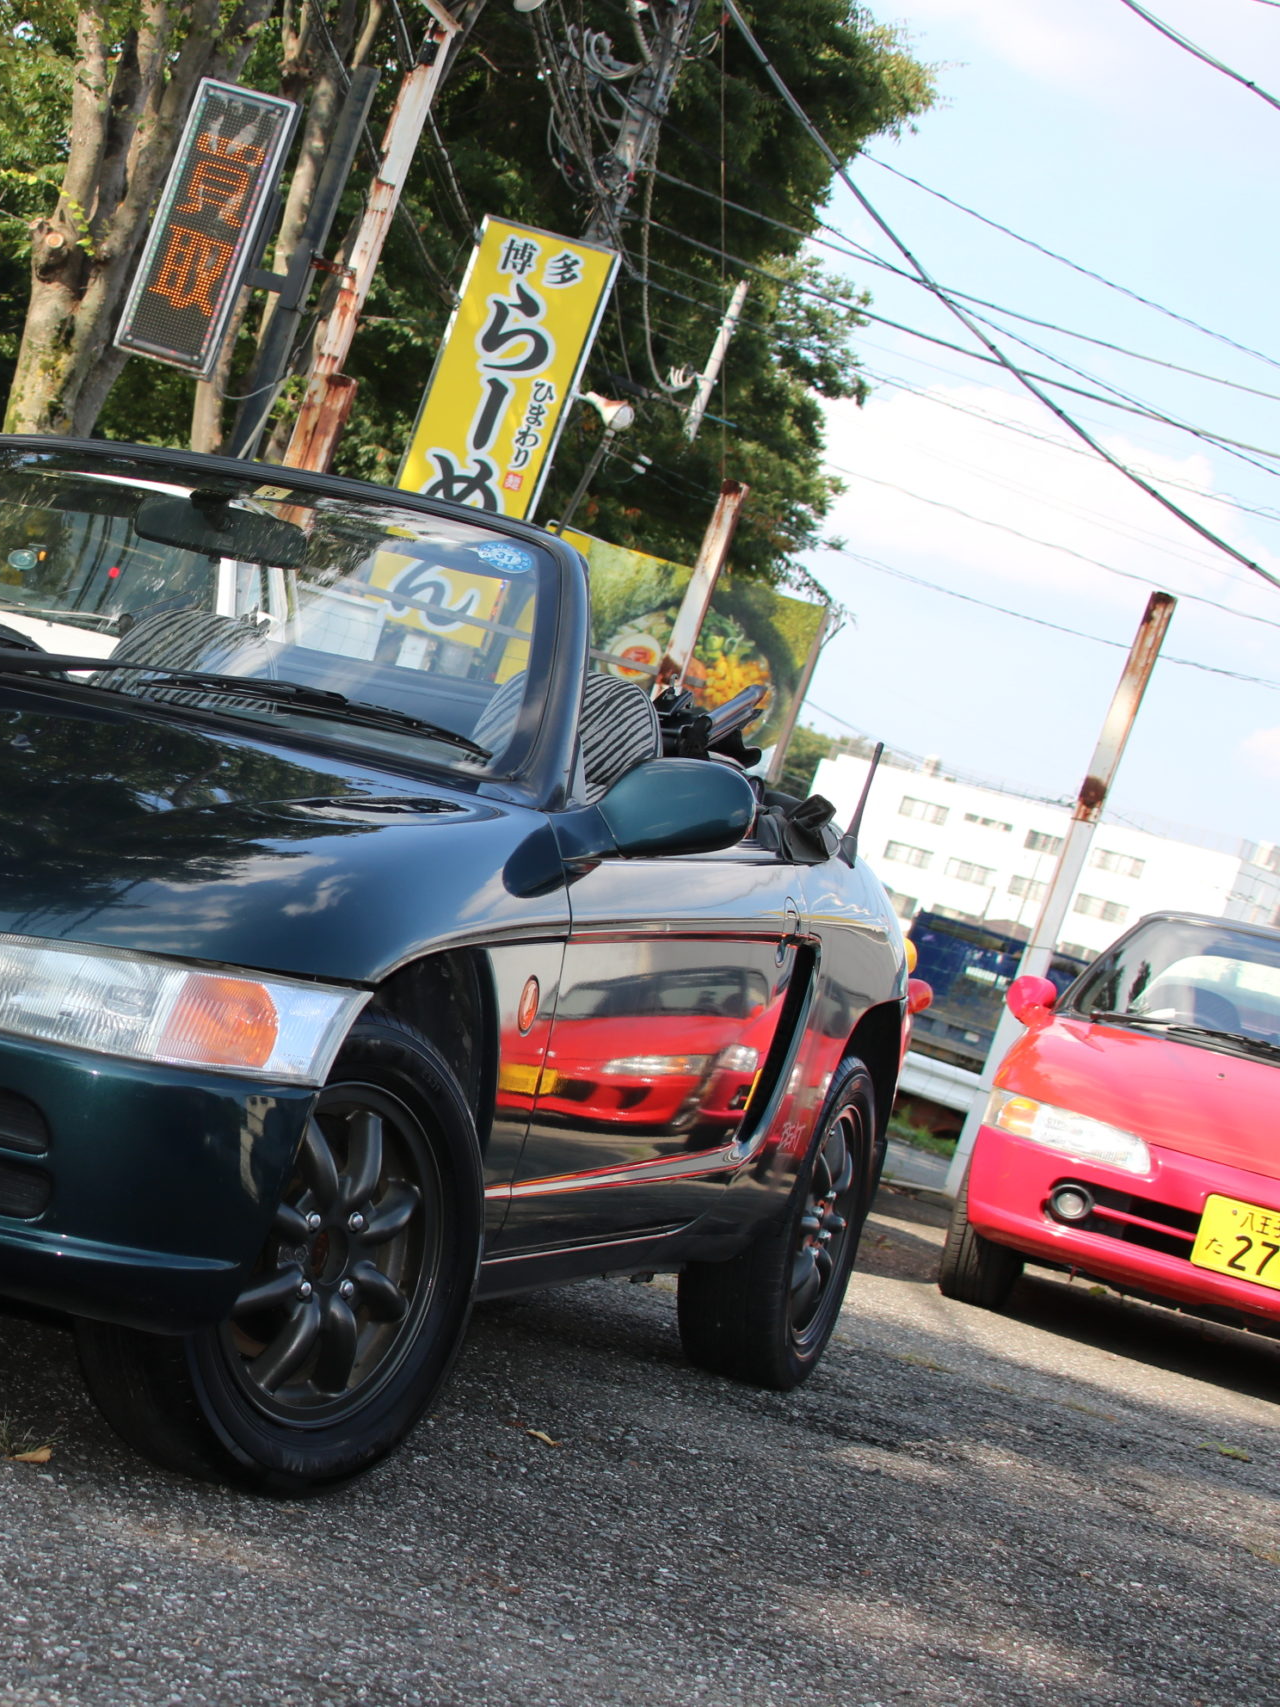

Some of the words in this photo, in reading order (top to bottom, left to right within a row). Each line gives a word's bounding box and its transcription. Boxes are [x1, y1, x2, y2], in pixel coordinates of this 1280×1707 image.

[148, 131, 266, 318] 買取
[500, 238, 582, 286] 博多
[509, 380, 555, 469] ひまわり
[496, 551, 514, 563] 31
[1204, 1237, 1224, 1255] た
[1226, 1235, 1280, 1277] 27
